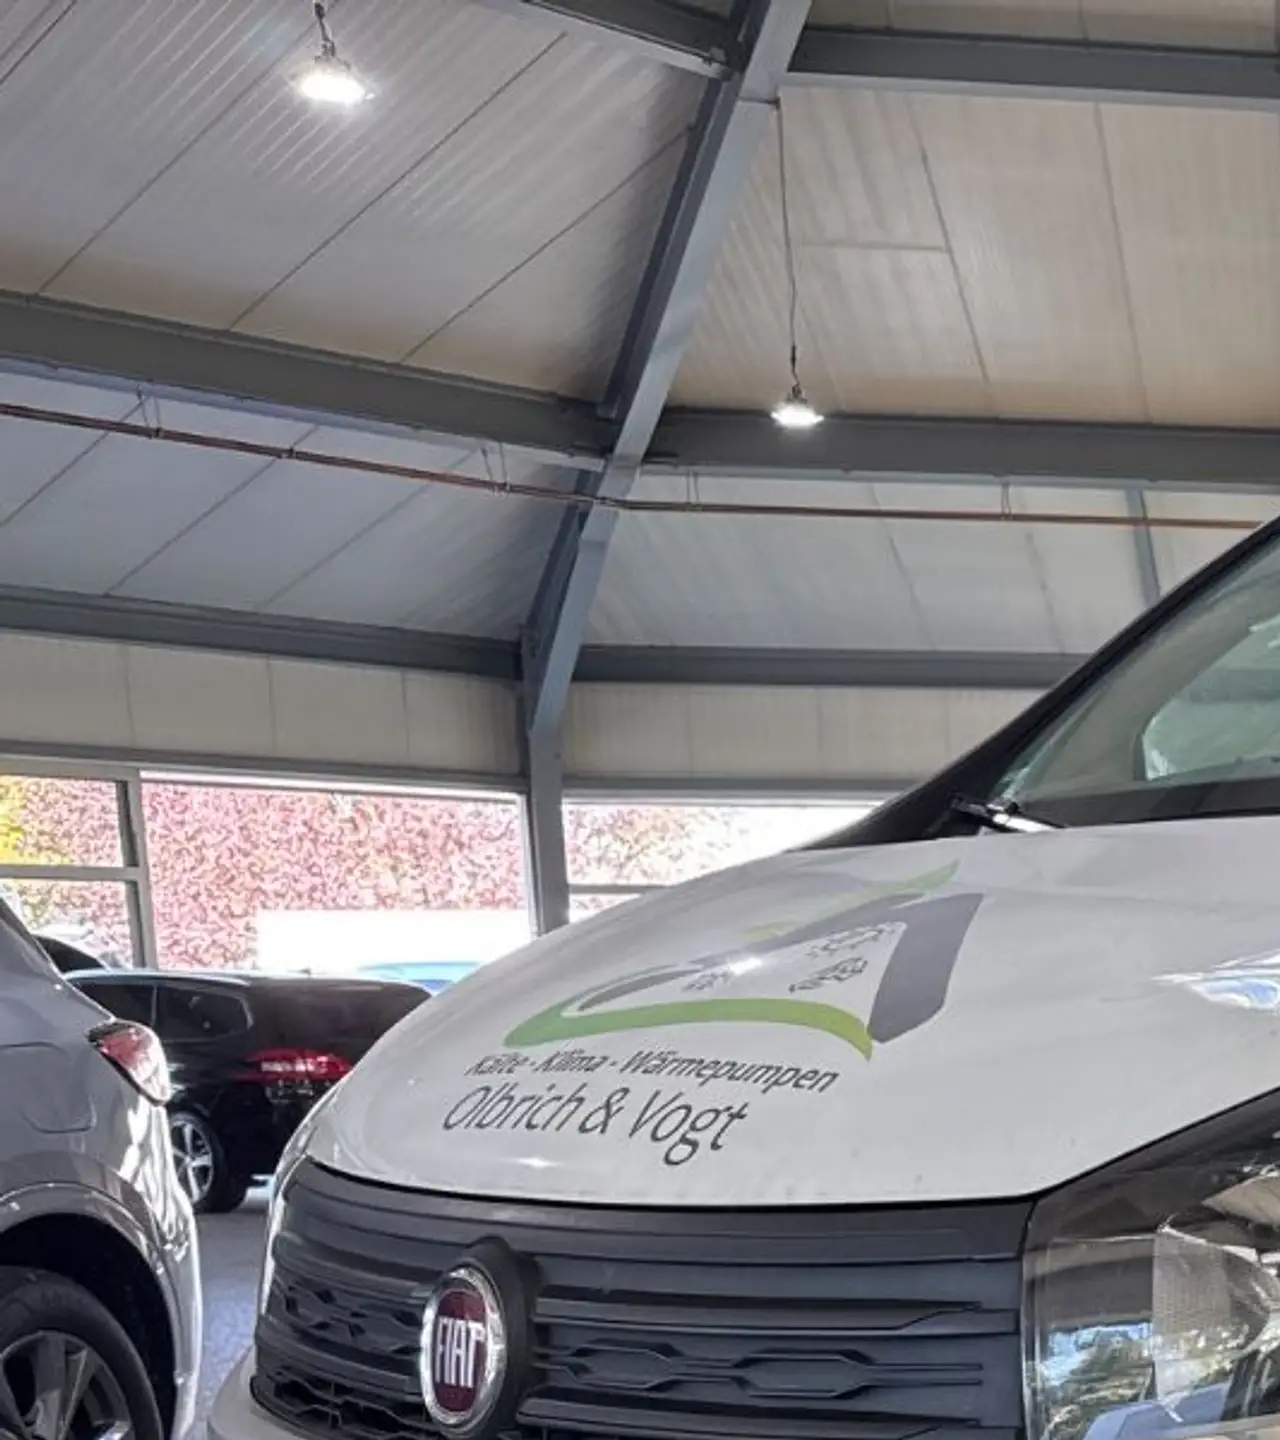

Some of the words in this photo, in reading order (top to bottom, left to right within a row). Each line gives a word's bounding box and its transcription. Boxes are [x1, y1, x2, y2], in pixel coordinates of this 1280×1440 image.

[463, 1052, 529, 1076] Kälte
[533, 1049, 609, 1073] Klima
[619, 1050, 840, 1094] Wärmepumpen
[443, 1082, 588, 1131] Olbrich
[578, 1087, 631, 1134] &
[629, 1089, 749, 1166] Vogt
[434, 1315, 485, 1388] FIAT
